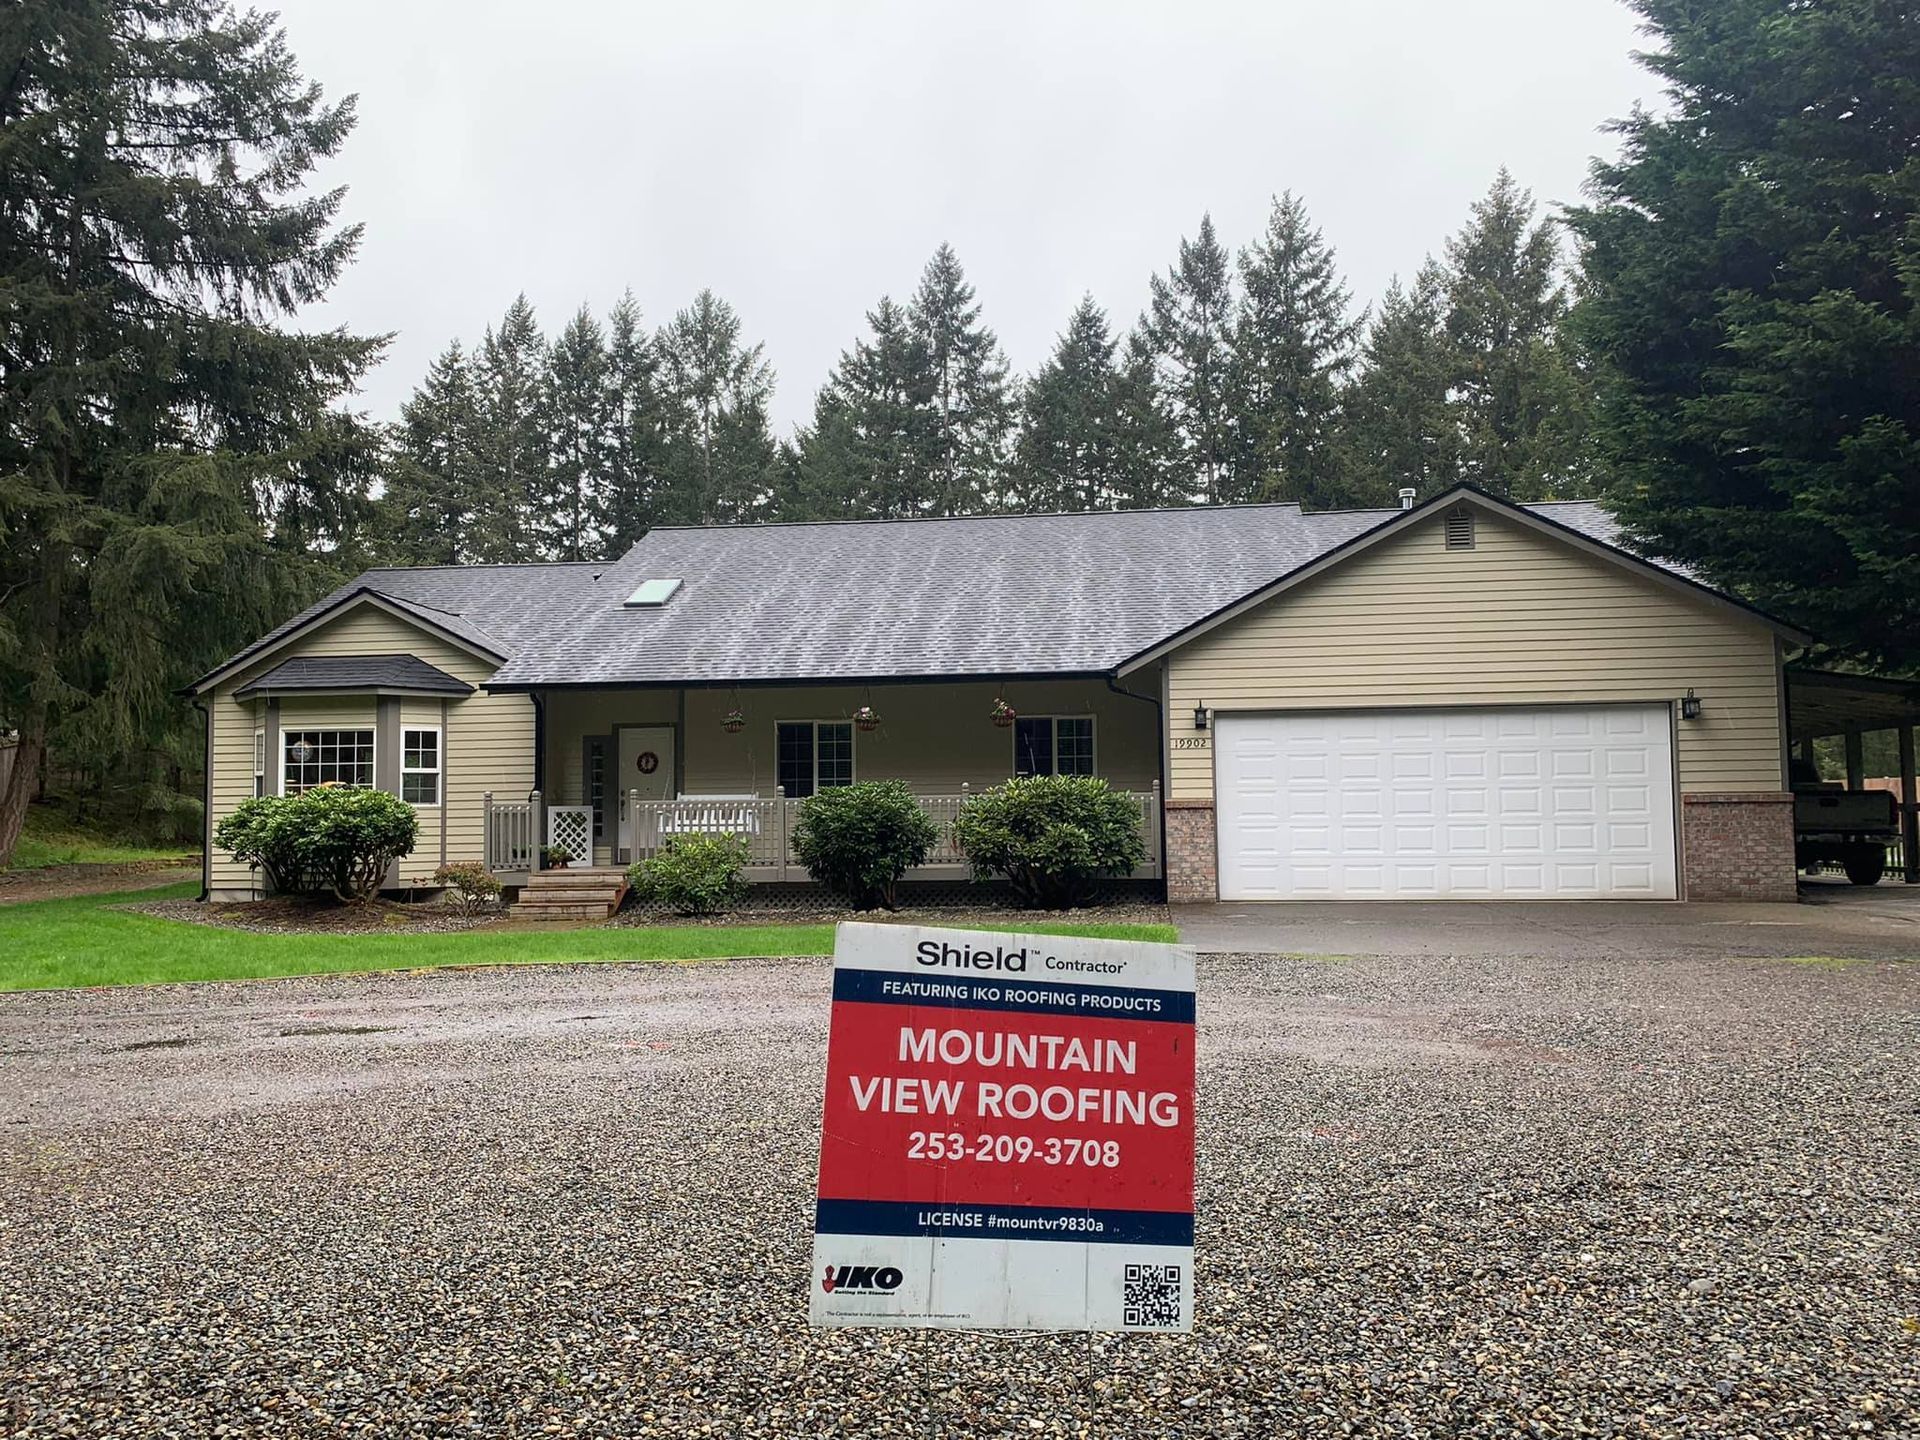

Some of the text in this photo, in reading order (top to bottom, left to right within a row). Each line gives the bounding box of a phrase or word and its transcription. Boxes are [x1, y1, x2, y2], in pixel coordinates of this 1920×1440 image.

[1175, 739, 1206, 749] 19902
[882, 981, 1162, 1012] FEATURING IKO ROOFING PRODUCTS
[899, 1027, 1137, 1074] MOUNTAIN
[849, 1076, 1179, 1128] VIEW ROOFING
[907, 1131, 1120, 1168] 253-209-3708
[918, 1212, 1104, 1232] LICENSE #mountvr9830a
[834, 1266, 903, 1289] IKO
